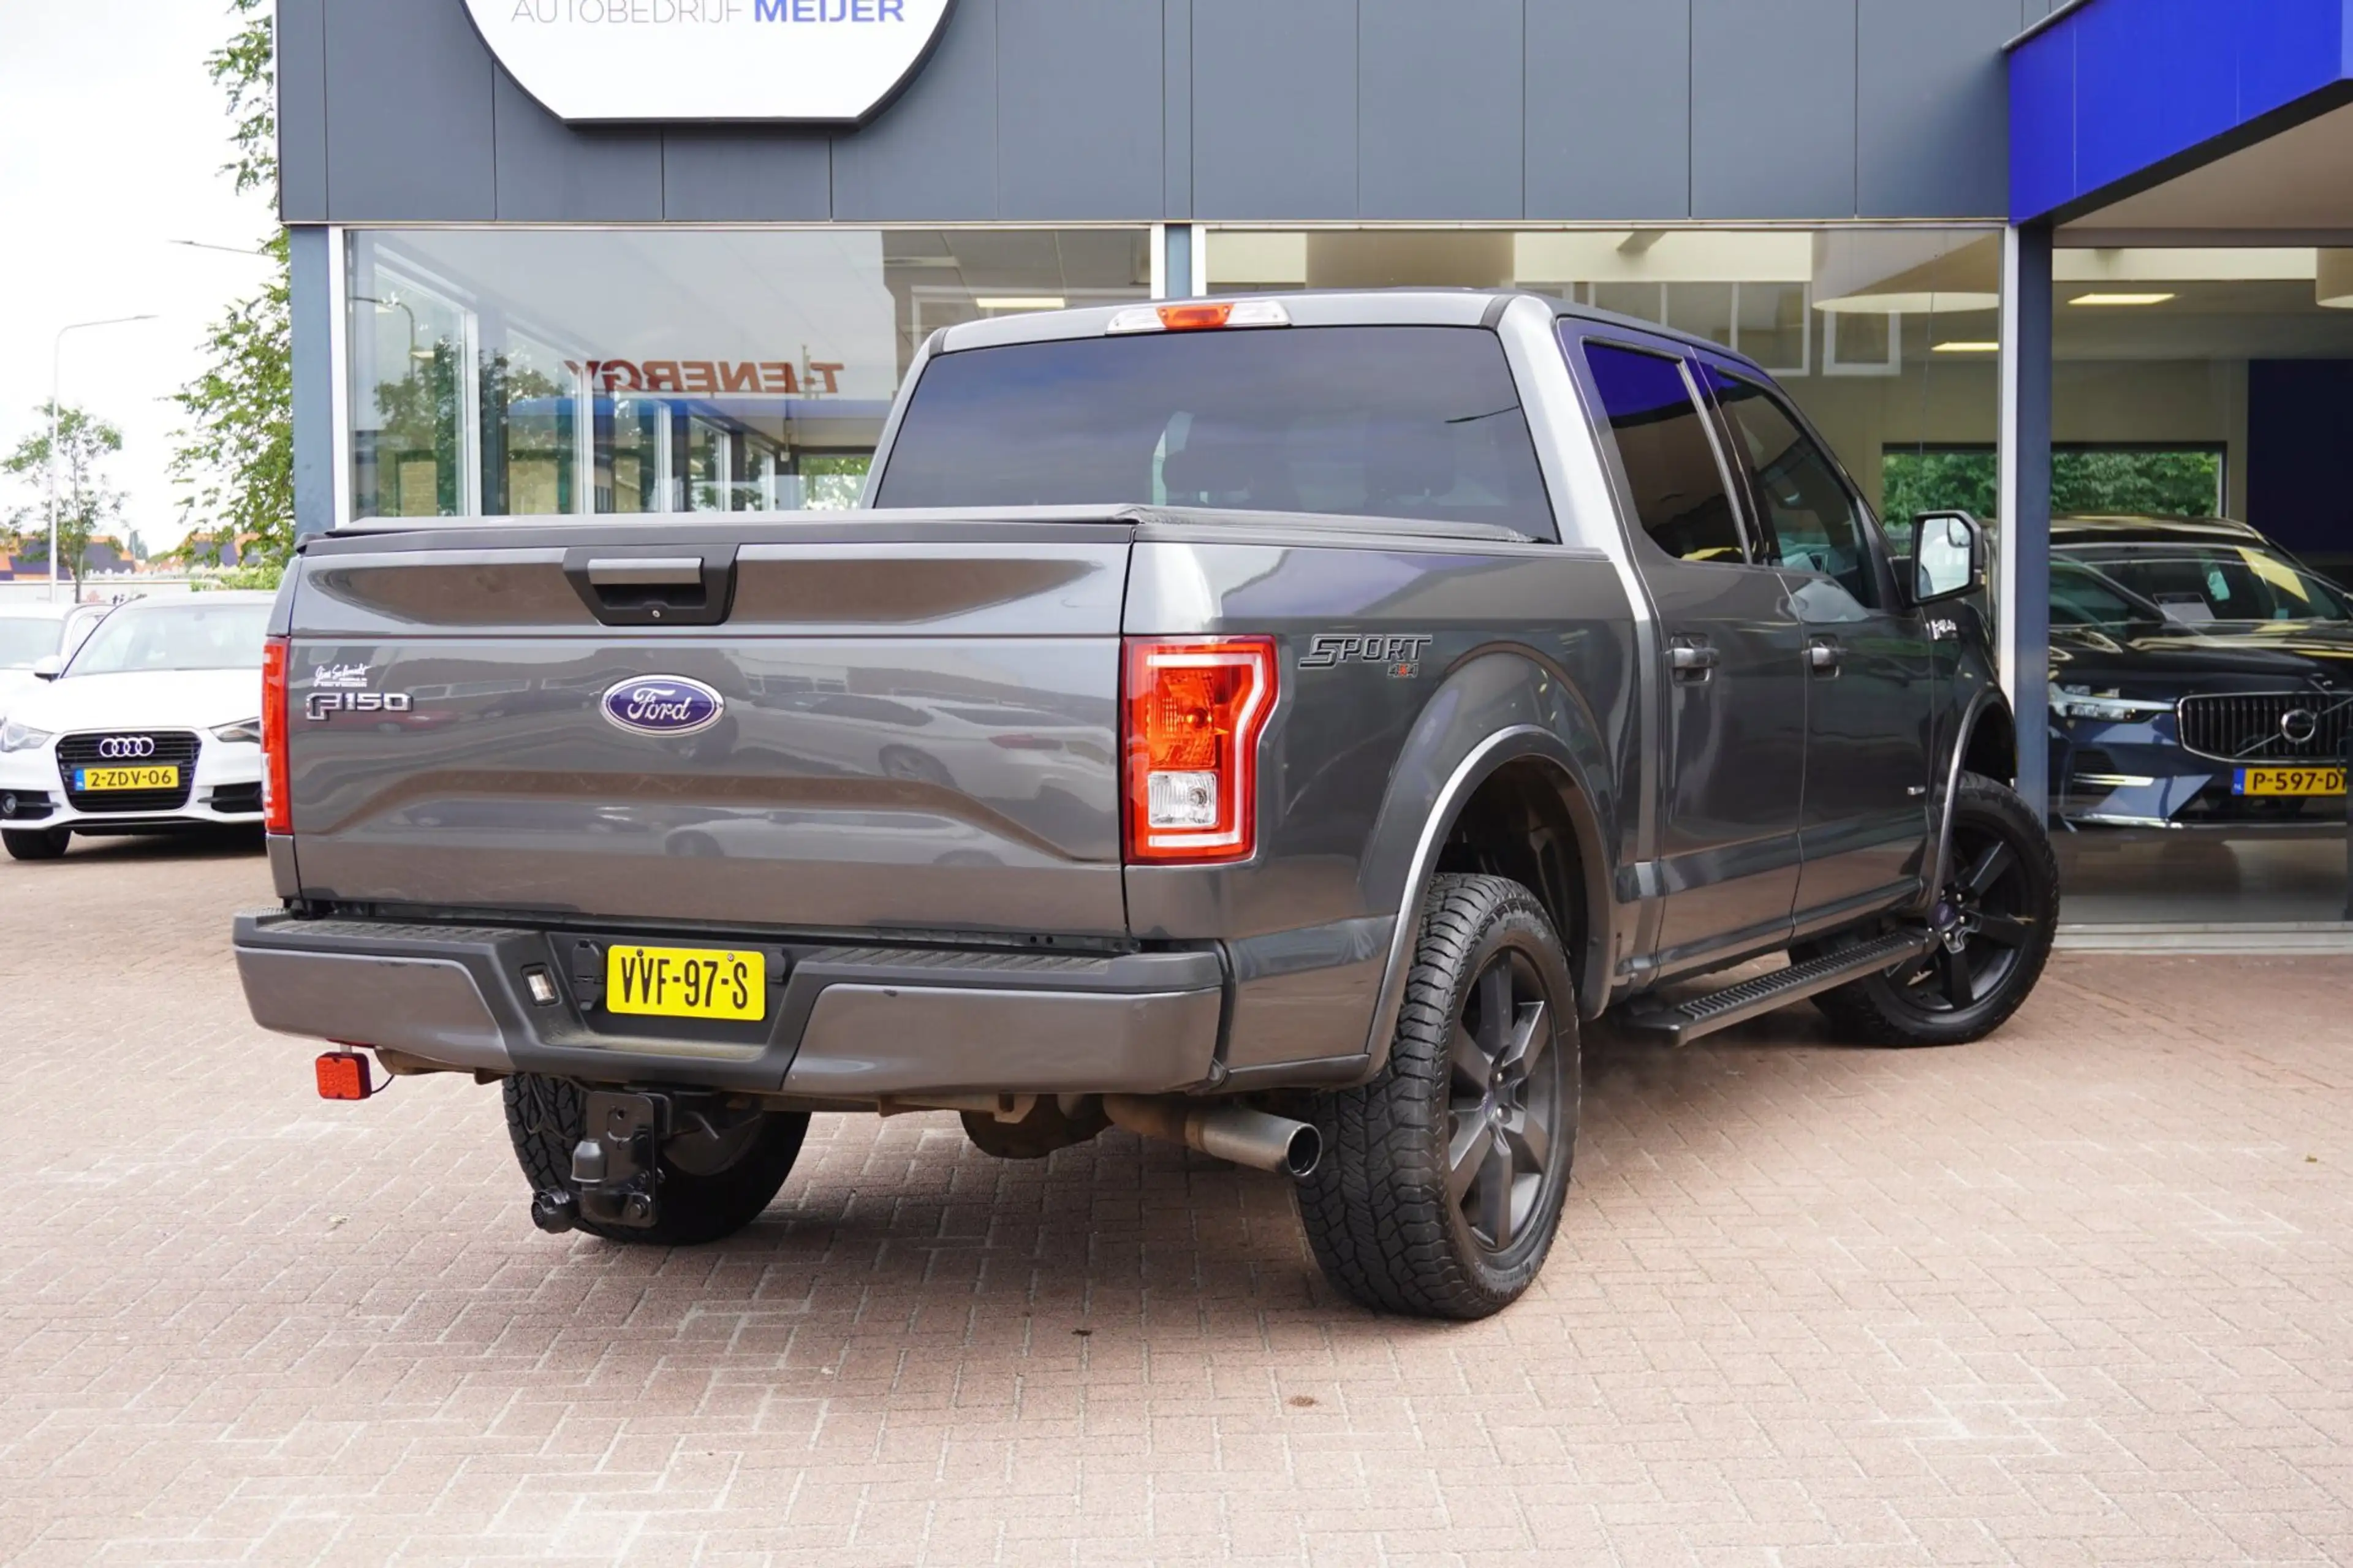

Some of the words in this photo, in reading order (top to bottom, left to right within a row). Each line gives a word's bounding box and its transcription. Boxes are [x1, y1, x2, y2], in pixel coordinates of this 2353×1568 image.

[511, 0, 742, 23] AUTOBEDRIJF
[754, 0, 904, 22] MEIJER
[1298, 634, 1433, 669] SPORT
[306, 692, 413, 721] F150
[627, 687, 692, 720] Ford
[91, 770, 172, 787] 2-ZDV-06
[621, 956, 748, 1010] VVF-97-S
